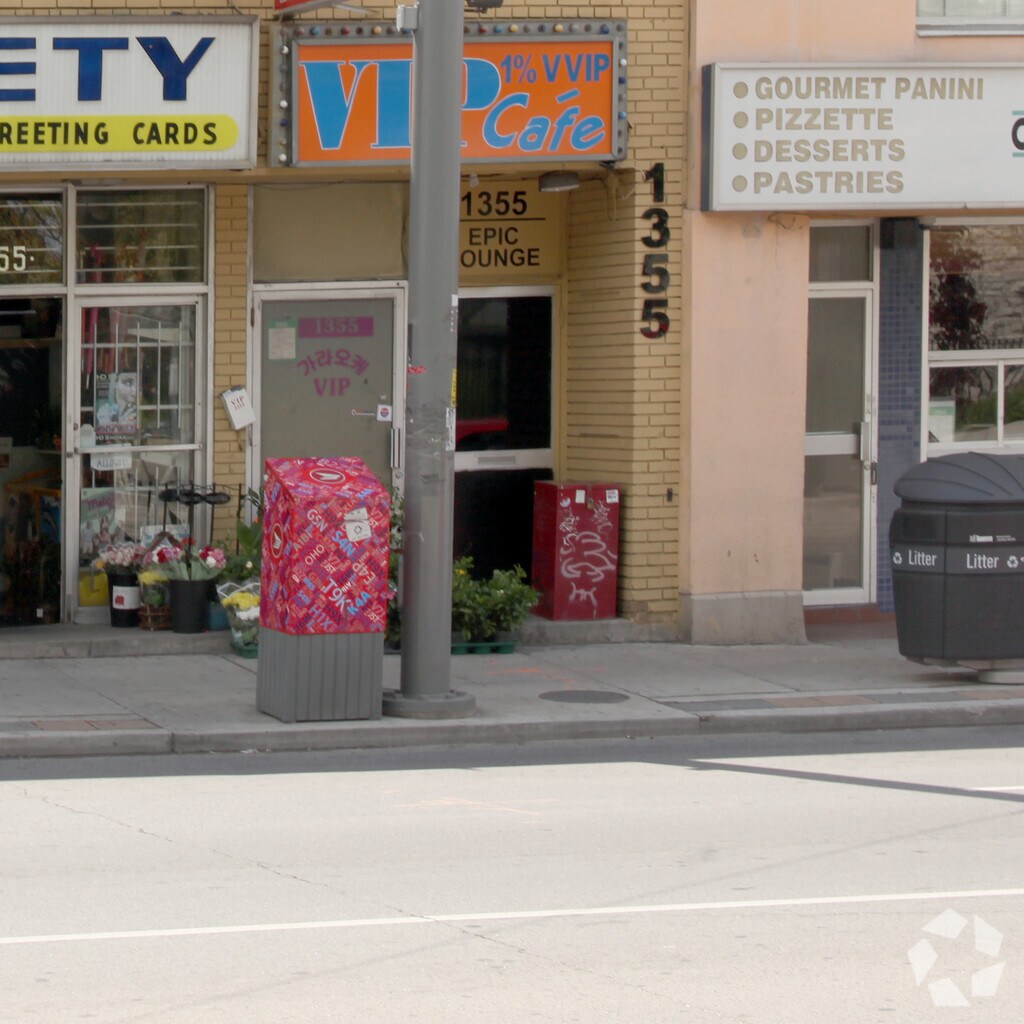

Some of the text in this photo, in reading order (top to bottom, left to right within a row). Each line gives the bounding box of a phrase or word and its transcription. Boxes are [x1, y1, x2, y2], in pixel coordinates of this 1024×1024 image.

[501, 53, 610, 84] 1% VVIP
[755, 77, 984, 100] GOURMET PANINI
[482, 88, 606, 152] Café
[755, 107, 894, 131] PIZZETTE
[132, 121, 218, 145] CARDS
[754, 138, 906, 163] DESSERTS
[753, 170, 904, 194] PASTRIES
[461, 191, 528, 216] 1355
[468, 227, 519, 246] EPIC
[460, 248, 541, 268] OUNGE
[640, 162, 671, 340] 1355
[314, 317, 360, 334] 1355
[313, 377, 352, 397] VIP
[908, 549, 938, 567] Litter
[966, 553, 999, 569] Litter
